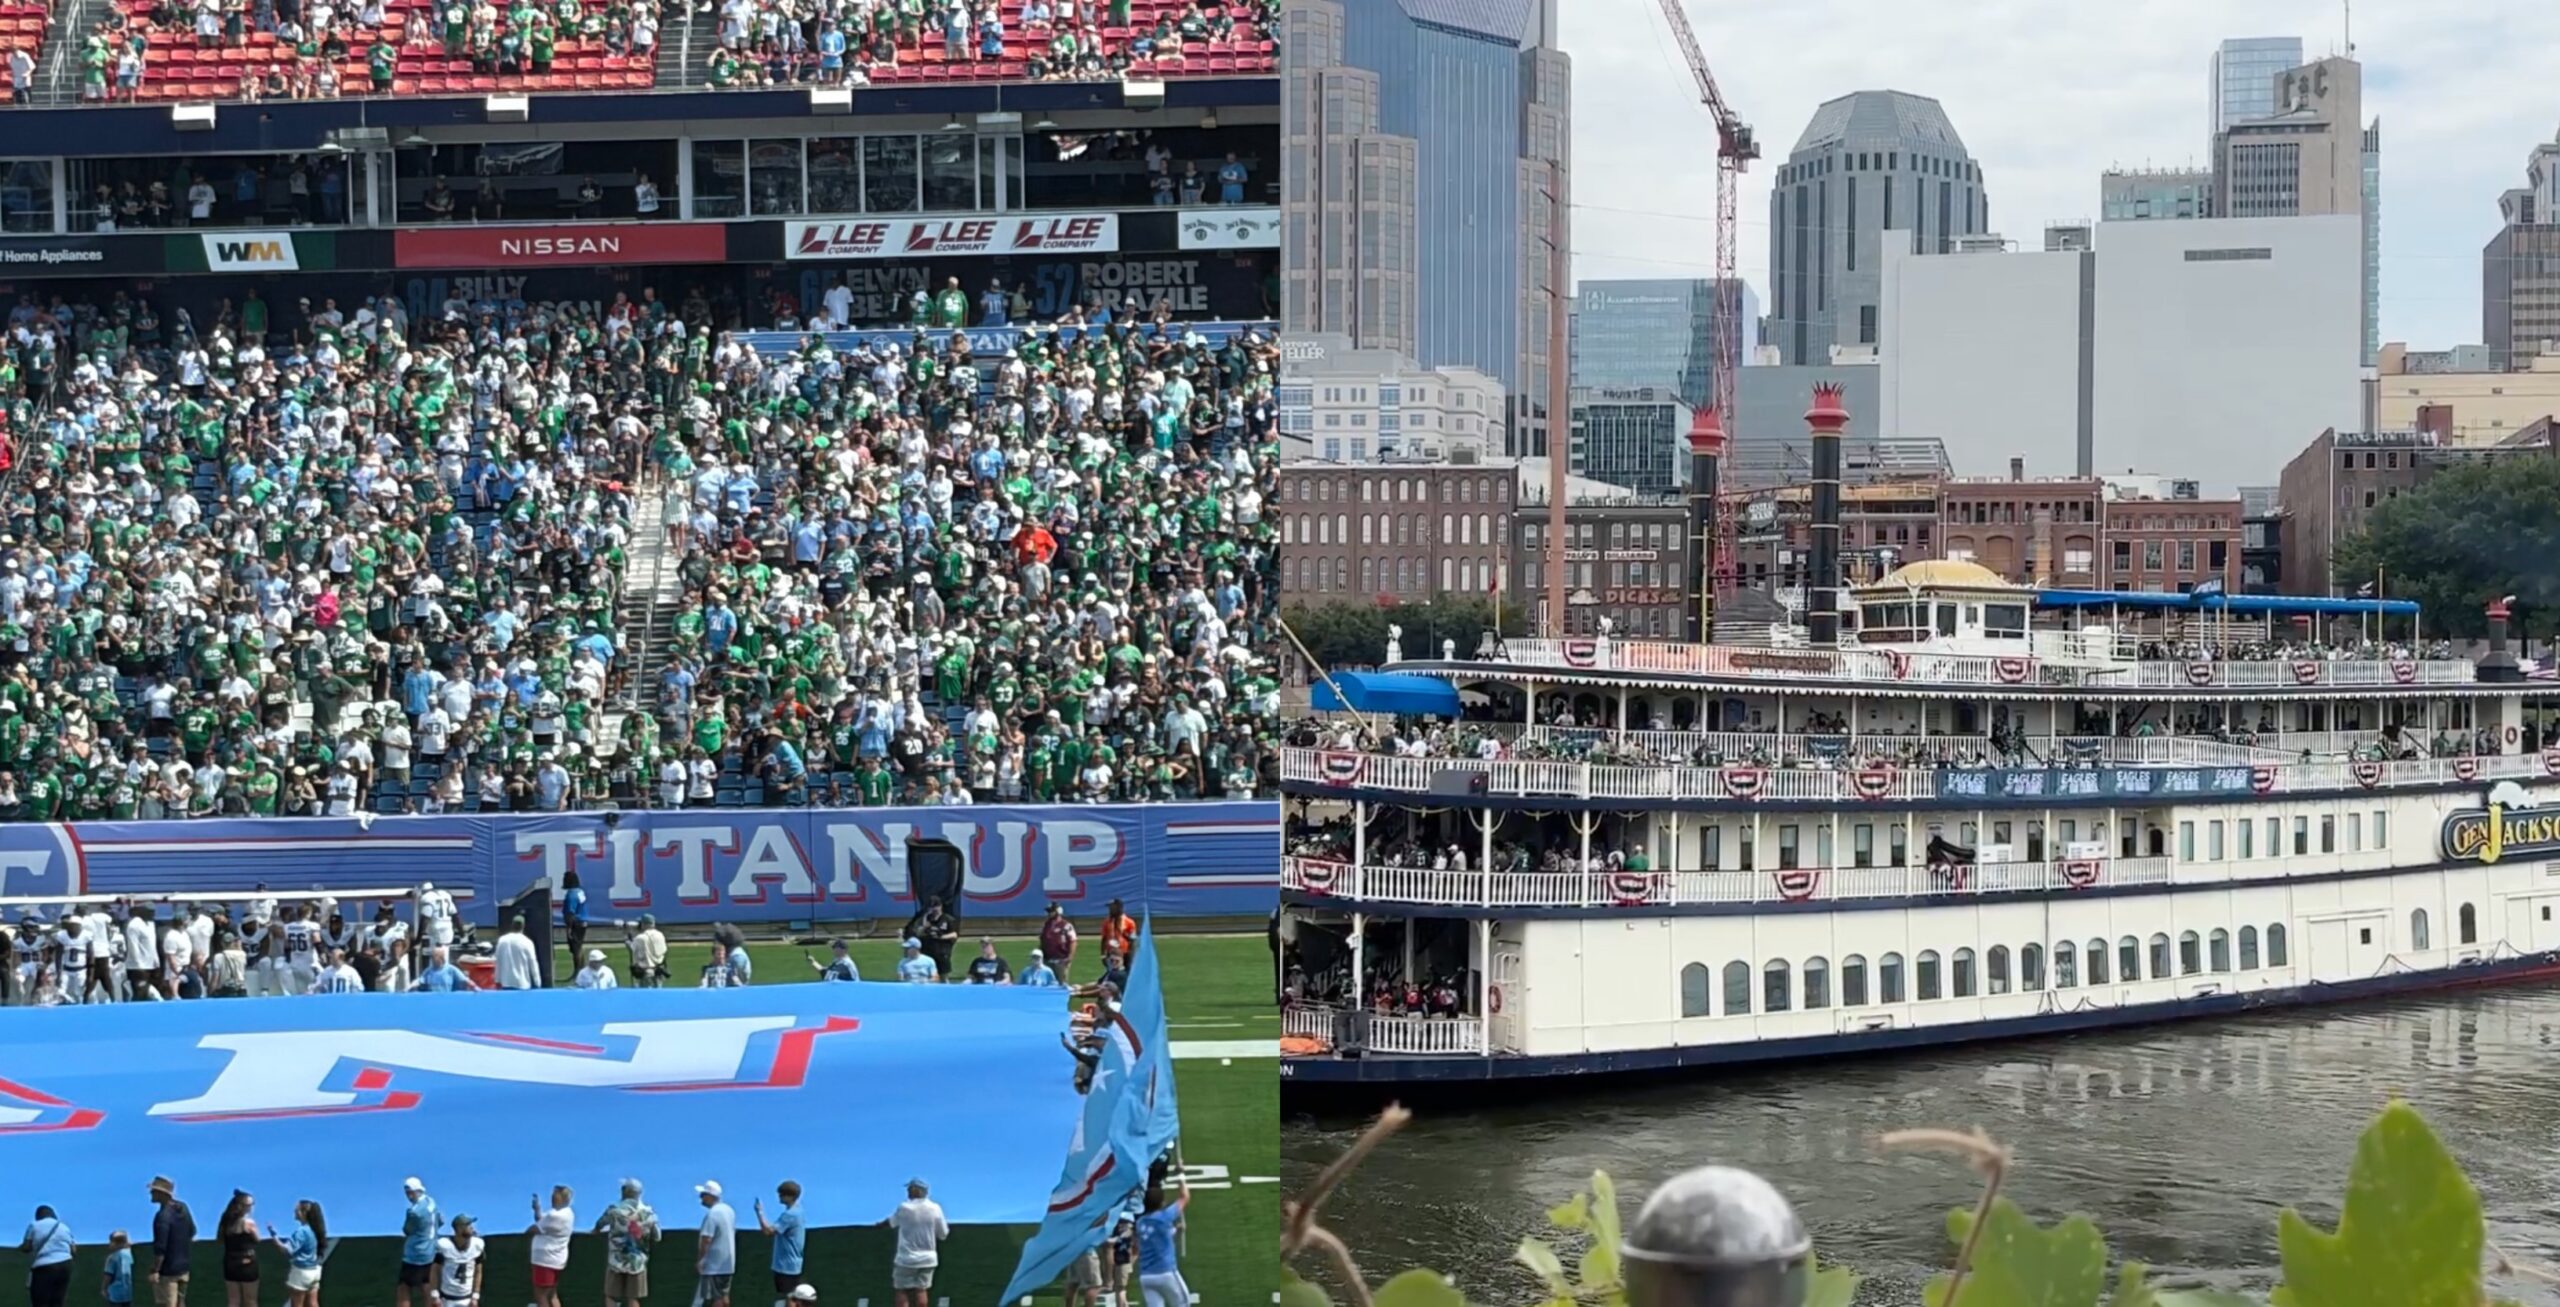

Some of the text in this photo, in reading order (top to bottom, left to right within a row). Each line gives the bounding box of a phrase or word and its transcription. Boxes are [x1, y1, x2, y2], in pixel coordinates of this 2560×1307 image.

[832, 223, 890, 244] LEE
[940, 220, 998, 242] LEE
[1047, 217, 1106, 239] LEE
[217, 242, 284, 262] WM
[502, 237, 619, 255] NISSAN
[828, 246, 881, 254] COMPANY
[936, 243, 988, 252] COMPANY
[1043, 239, 1097, 249] COMPANY
[5, 250, 38, 262] Home
[40, 248, 103, 264] Appliances
[847, 267, 930, 291] ELVIN
[1082, 260, 1199, 286] ROBERT
[454, 276, 528, 301] BILLY
[1035, 263, 1074, 315] 52
[188, 716, 206, 733] 27
[1948, 773, 1987, 784] EAGLES
[2006, 773, 2043, 784] EAGLES
[2061, 773, 2097, 783] EAGLES
[2116, 771, 2150, 782] EAGLES
[2166, 771, 2199, 782] EAGLES
[2215, 768, 2248, 779] EAGLES
[515, 820, 1126, 906] TITAN UP
